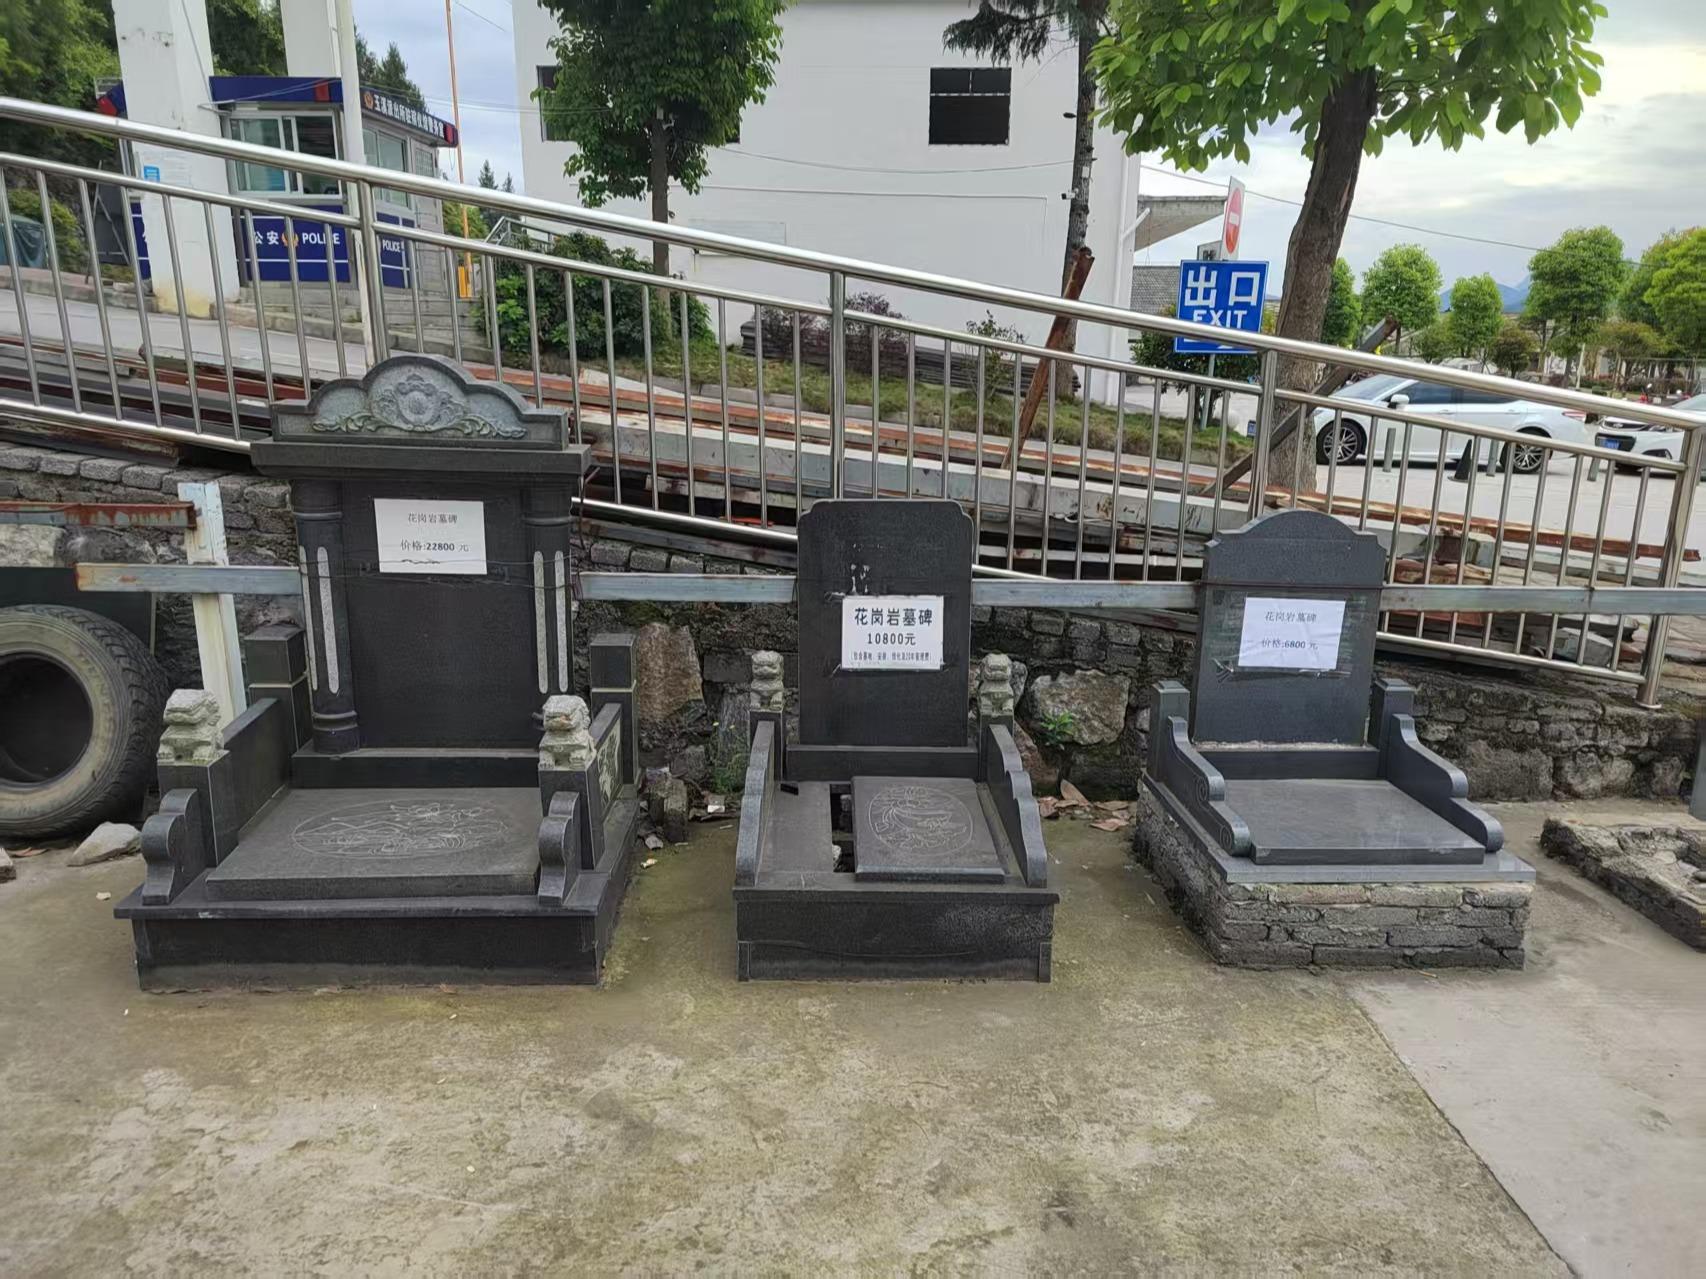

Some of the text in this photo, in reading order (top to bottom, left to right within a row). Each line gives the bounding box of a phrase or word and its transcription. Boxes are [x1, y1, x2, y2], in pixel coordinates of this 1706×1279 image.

[302, 232, 340, 245] POLIE
[382, 239, 401, 253] POLICE
[1184, 266, 1260, 308] 出口
[1193, 309, 1247, 329] EXIT
[408, 513, 457, 524] 花岗岩墓碑
[459, 544, 470, 553] 元
[854, 607, 933, 627] 花岗岩墓碑
[1265, 611, 1317, 623] 花岗岩墓碑
[867, 633, 916, 646] 10800元
